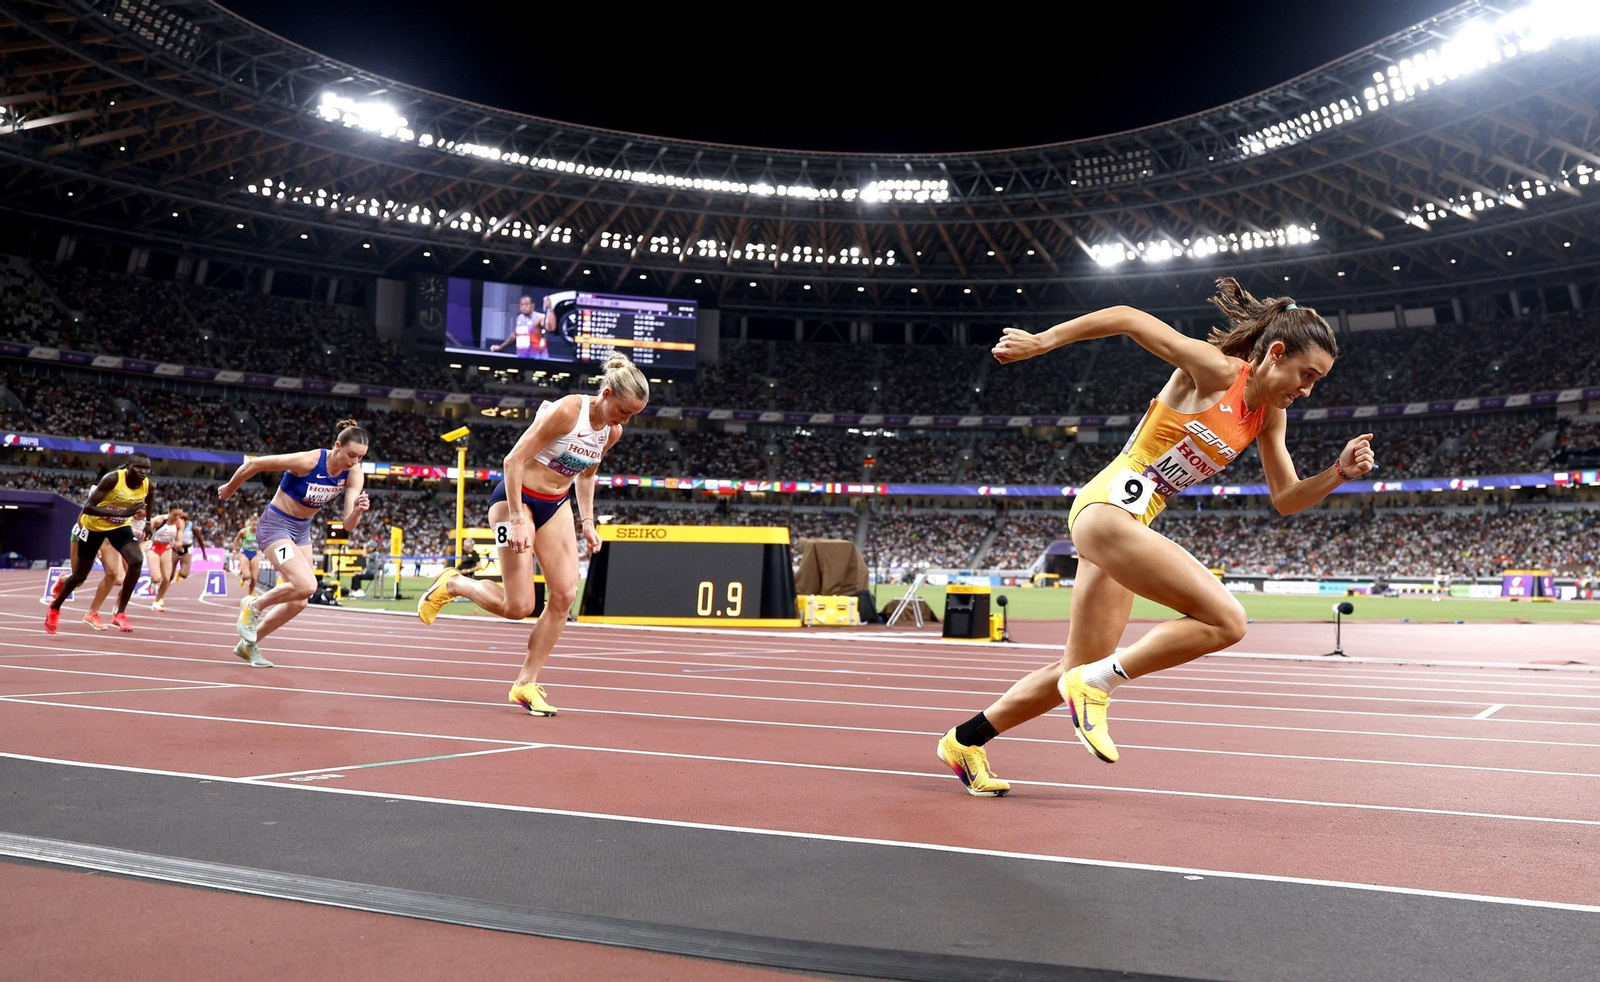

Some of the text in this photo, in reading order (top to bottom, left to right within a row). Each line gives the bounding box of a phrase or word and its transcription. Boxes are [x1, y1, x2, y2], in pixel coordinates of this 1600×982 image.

[1121, 479, 1143, 505] 9
[497, 525, 508, 544] 8
[616, 528, 667, 539] SEIKO
[279, 547, 286, 560] 7
[137, 576, 151, 595] 2
[210, 576, 220, 594] 1
[697, 581, 743, 617] 0.9
